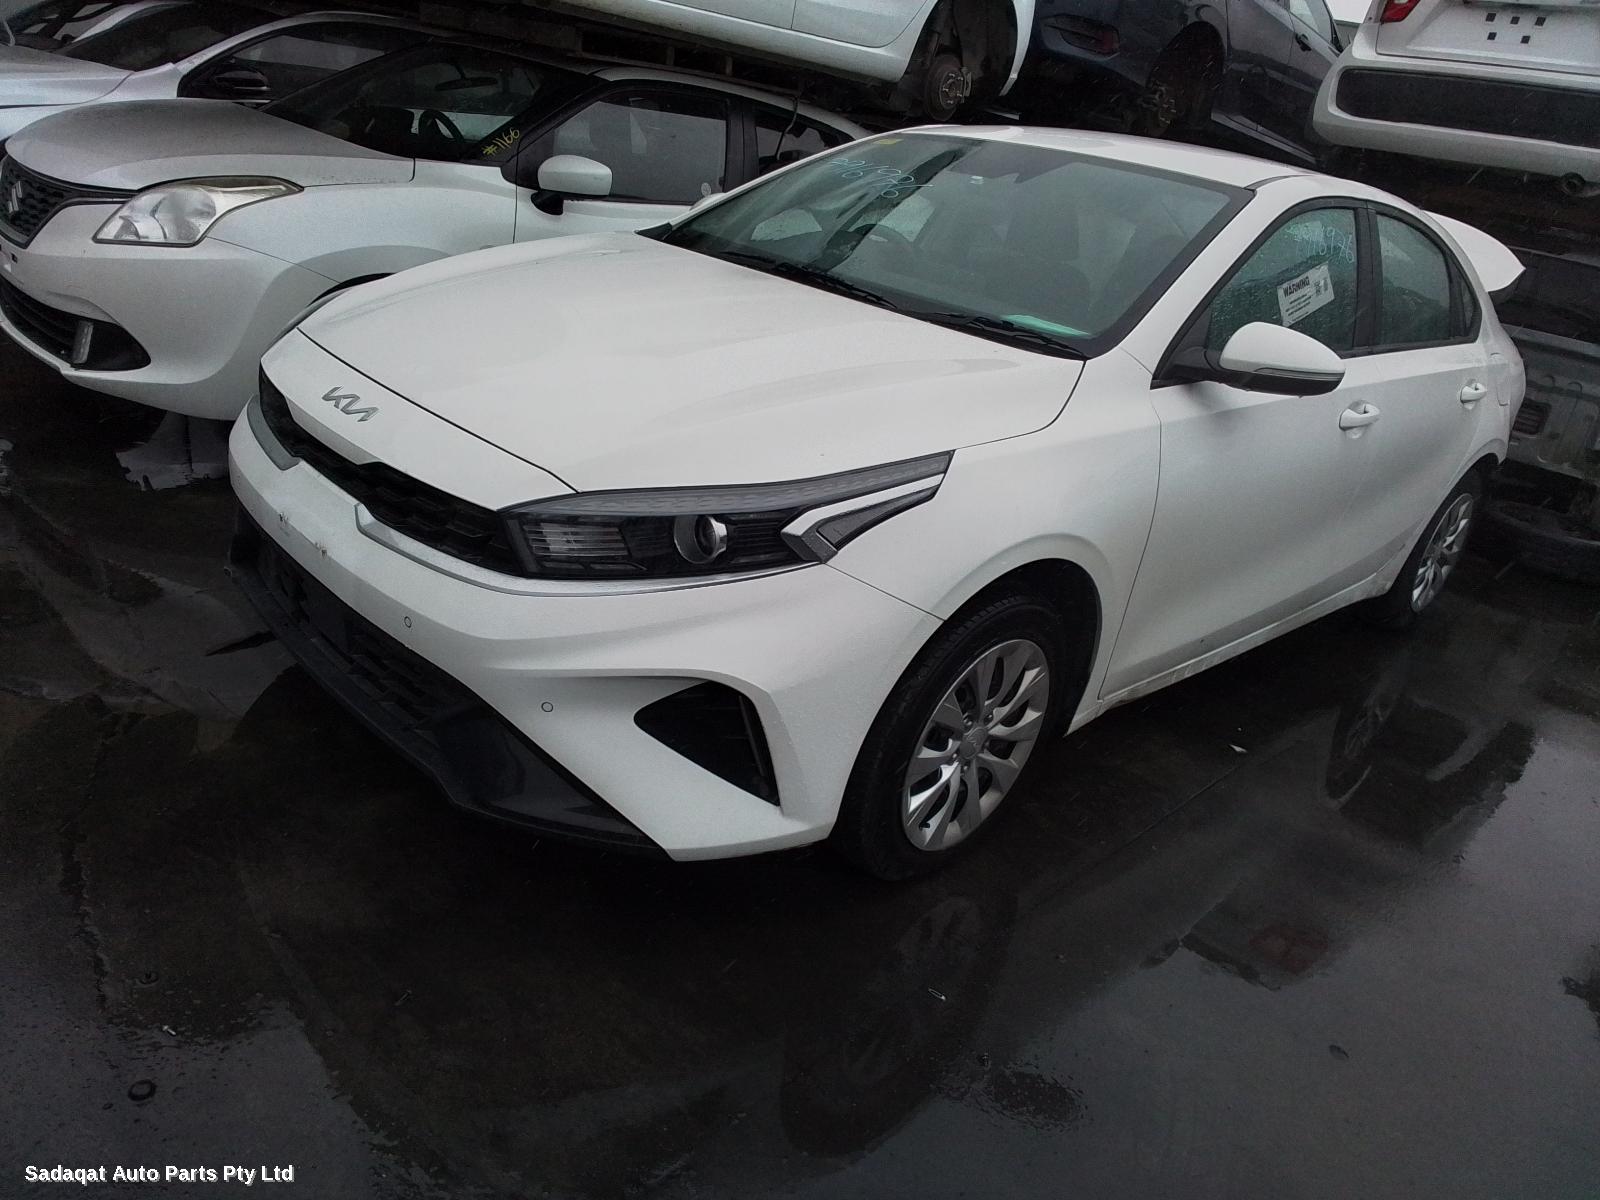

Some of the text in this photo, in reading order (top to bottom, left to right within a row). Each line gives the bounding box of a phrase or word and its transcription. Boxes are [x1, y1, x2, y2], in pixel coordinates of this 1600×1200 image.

[481, 127, 520, 157] #1166
[1282, 276, 1311, 298] WARNING
[321, 386, 380, 423] KIA
